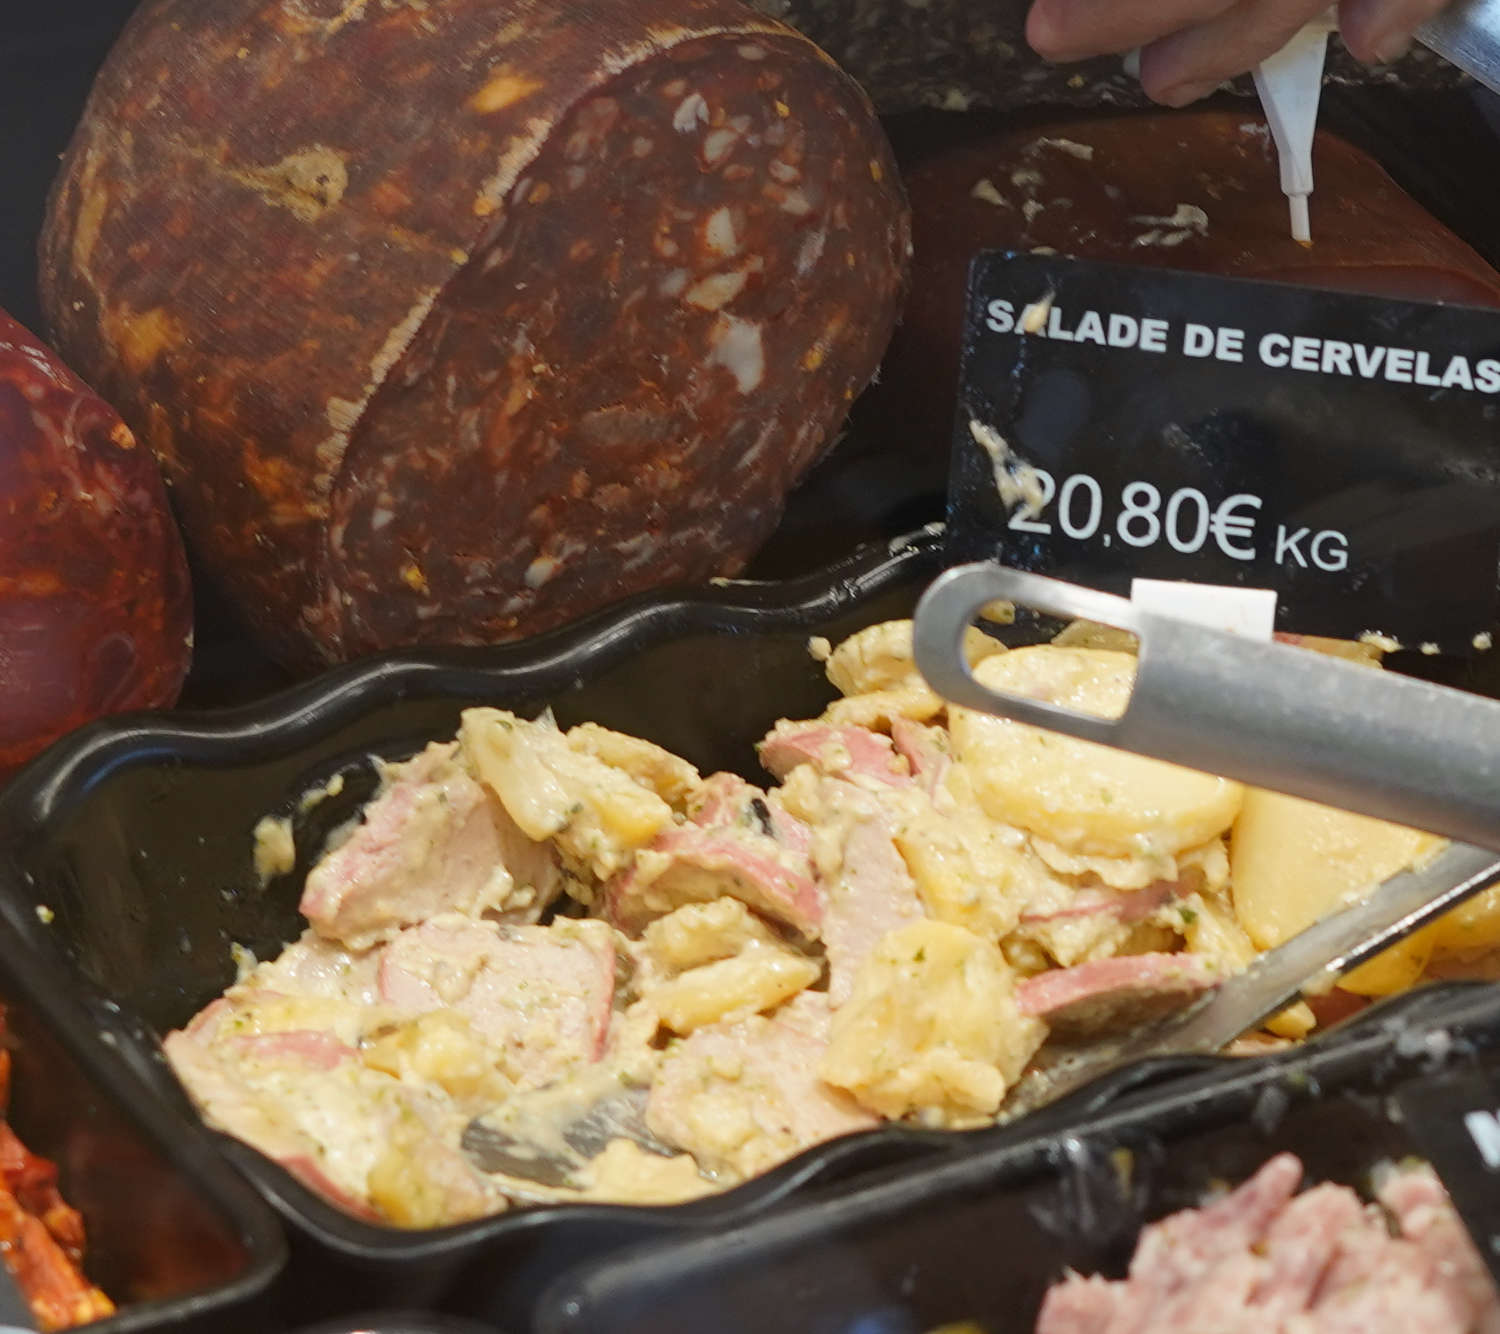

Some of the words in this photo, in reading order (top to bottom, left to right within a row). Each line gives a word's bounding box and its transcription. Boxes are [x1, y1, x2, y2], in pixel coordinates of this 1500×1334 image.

[1183, 323, 1244, 364] DE
[1008, 468, 1264, 562] 20,80€
[1274, 523, 1350, 572] KG
